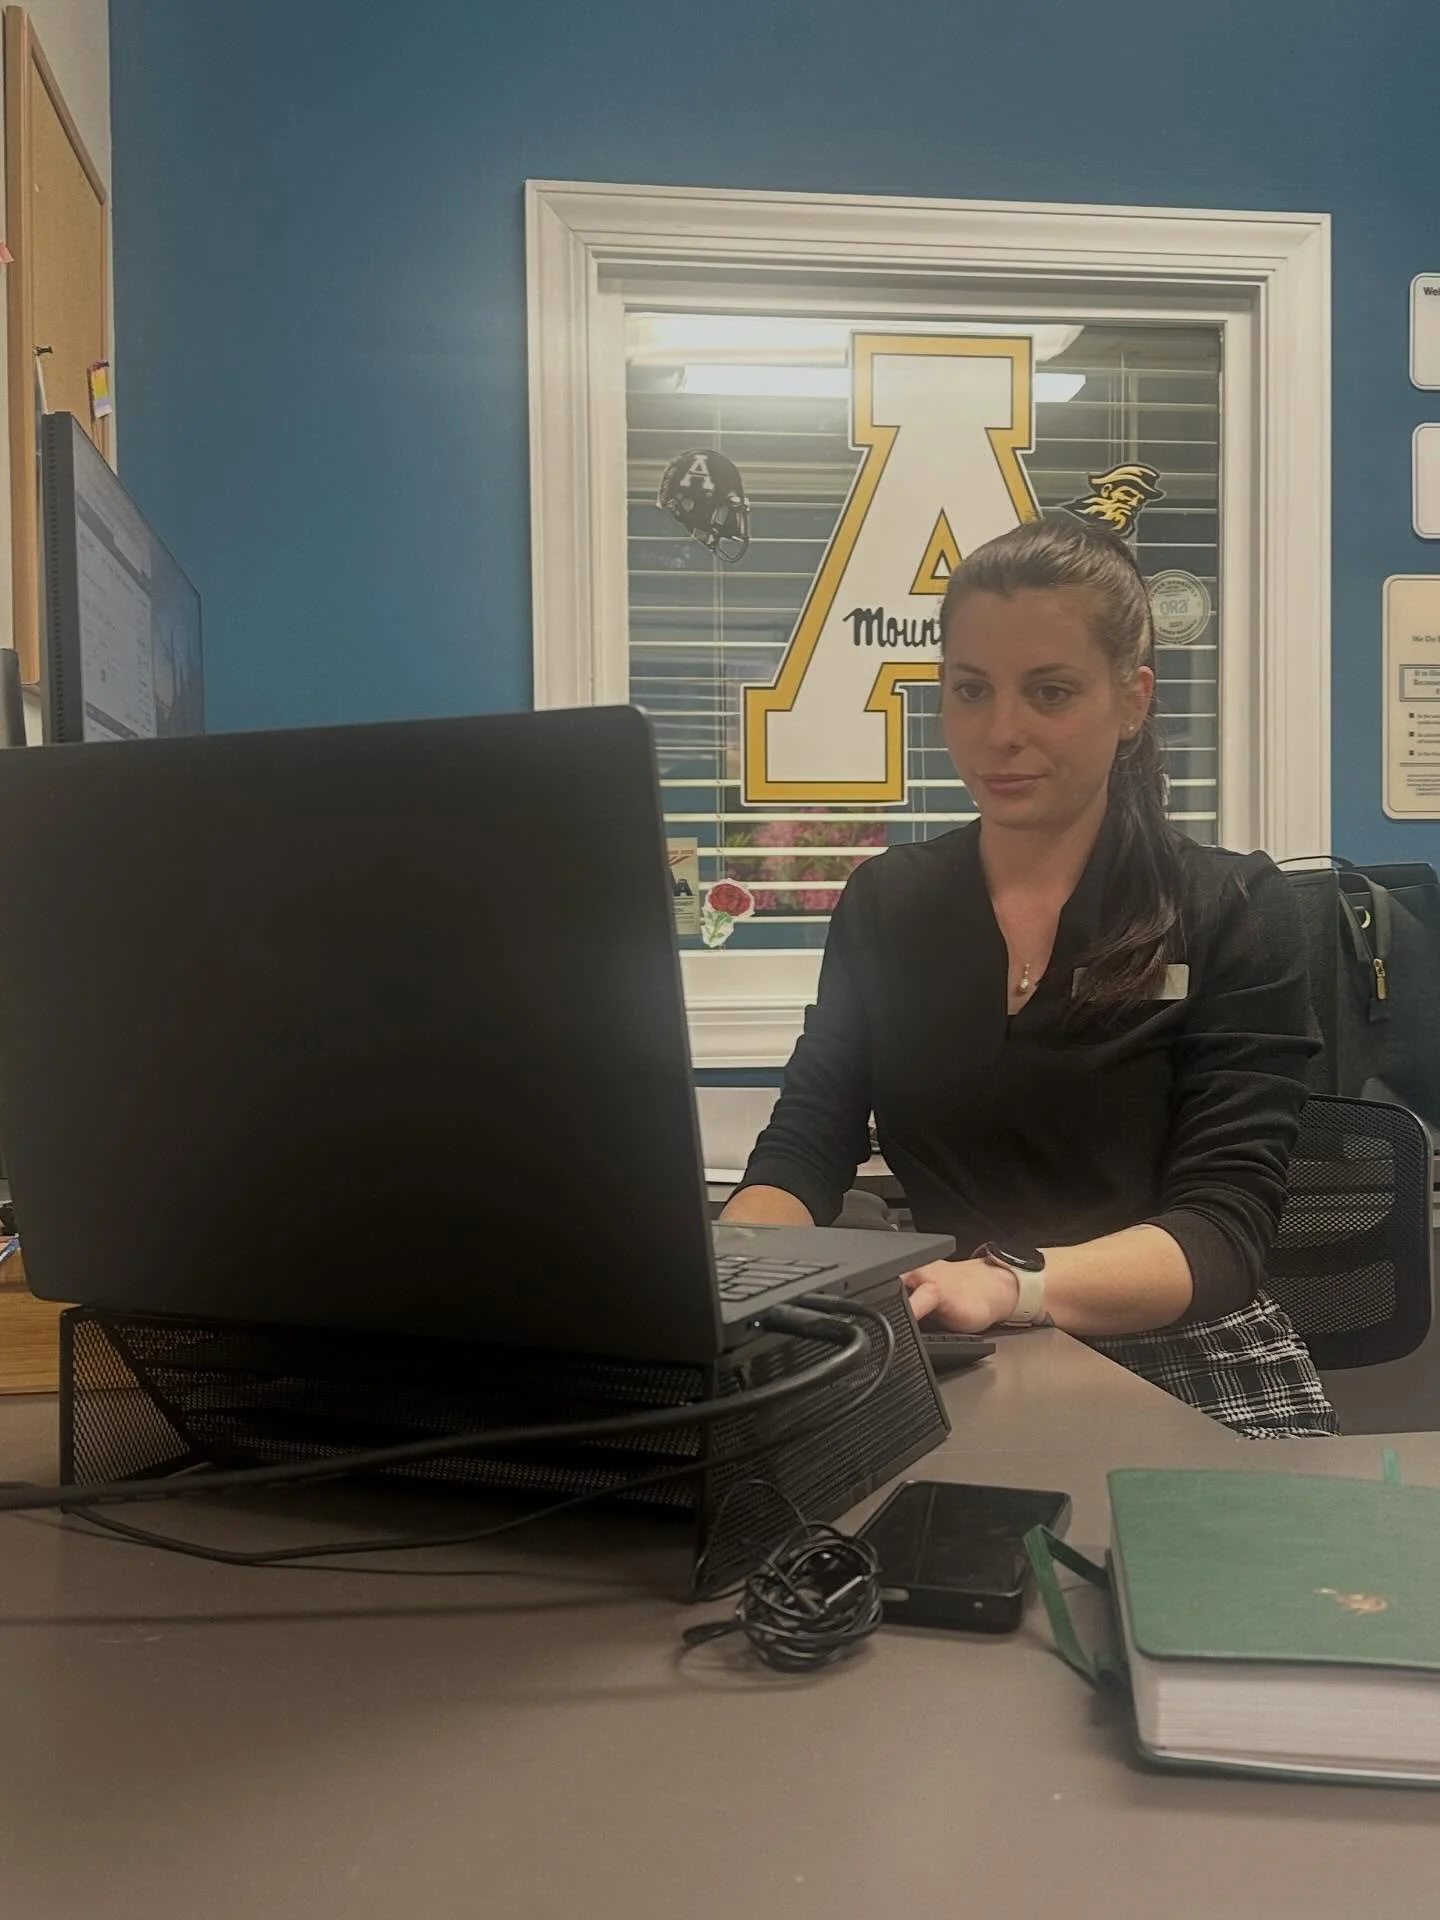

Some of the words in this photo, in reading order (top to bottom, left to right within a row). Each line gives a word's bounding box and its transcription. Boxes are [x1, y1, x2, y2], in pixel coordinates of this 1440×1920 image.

[680, 454, 715, 491] A
[741, 329, 1040, 806] A
[842, 606, 942, 648] Moun
